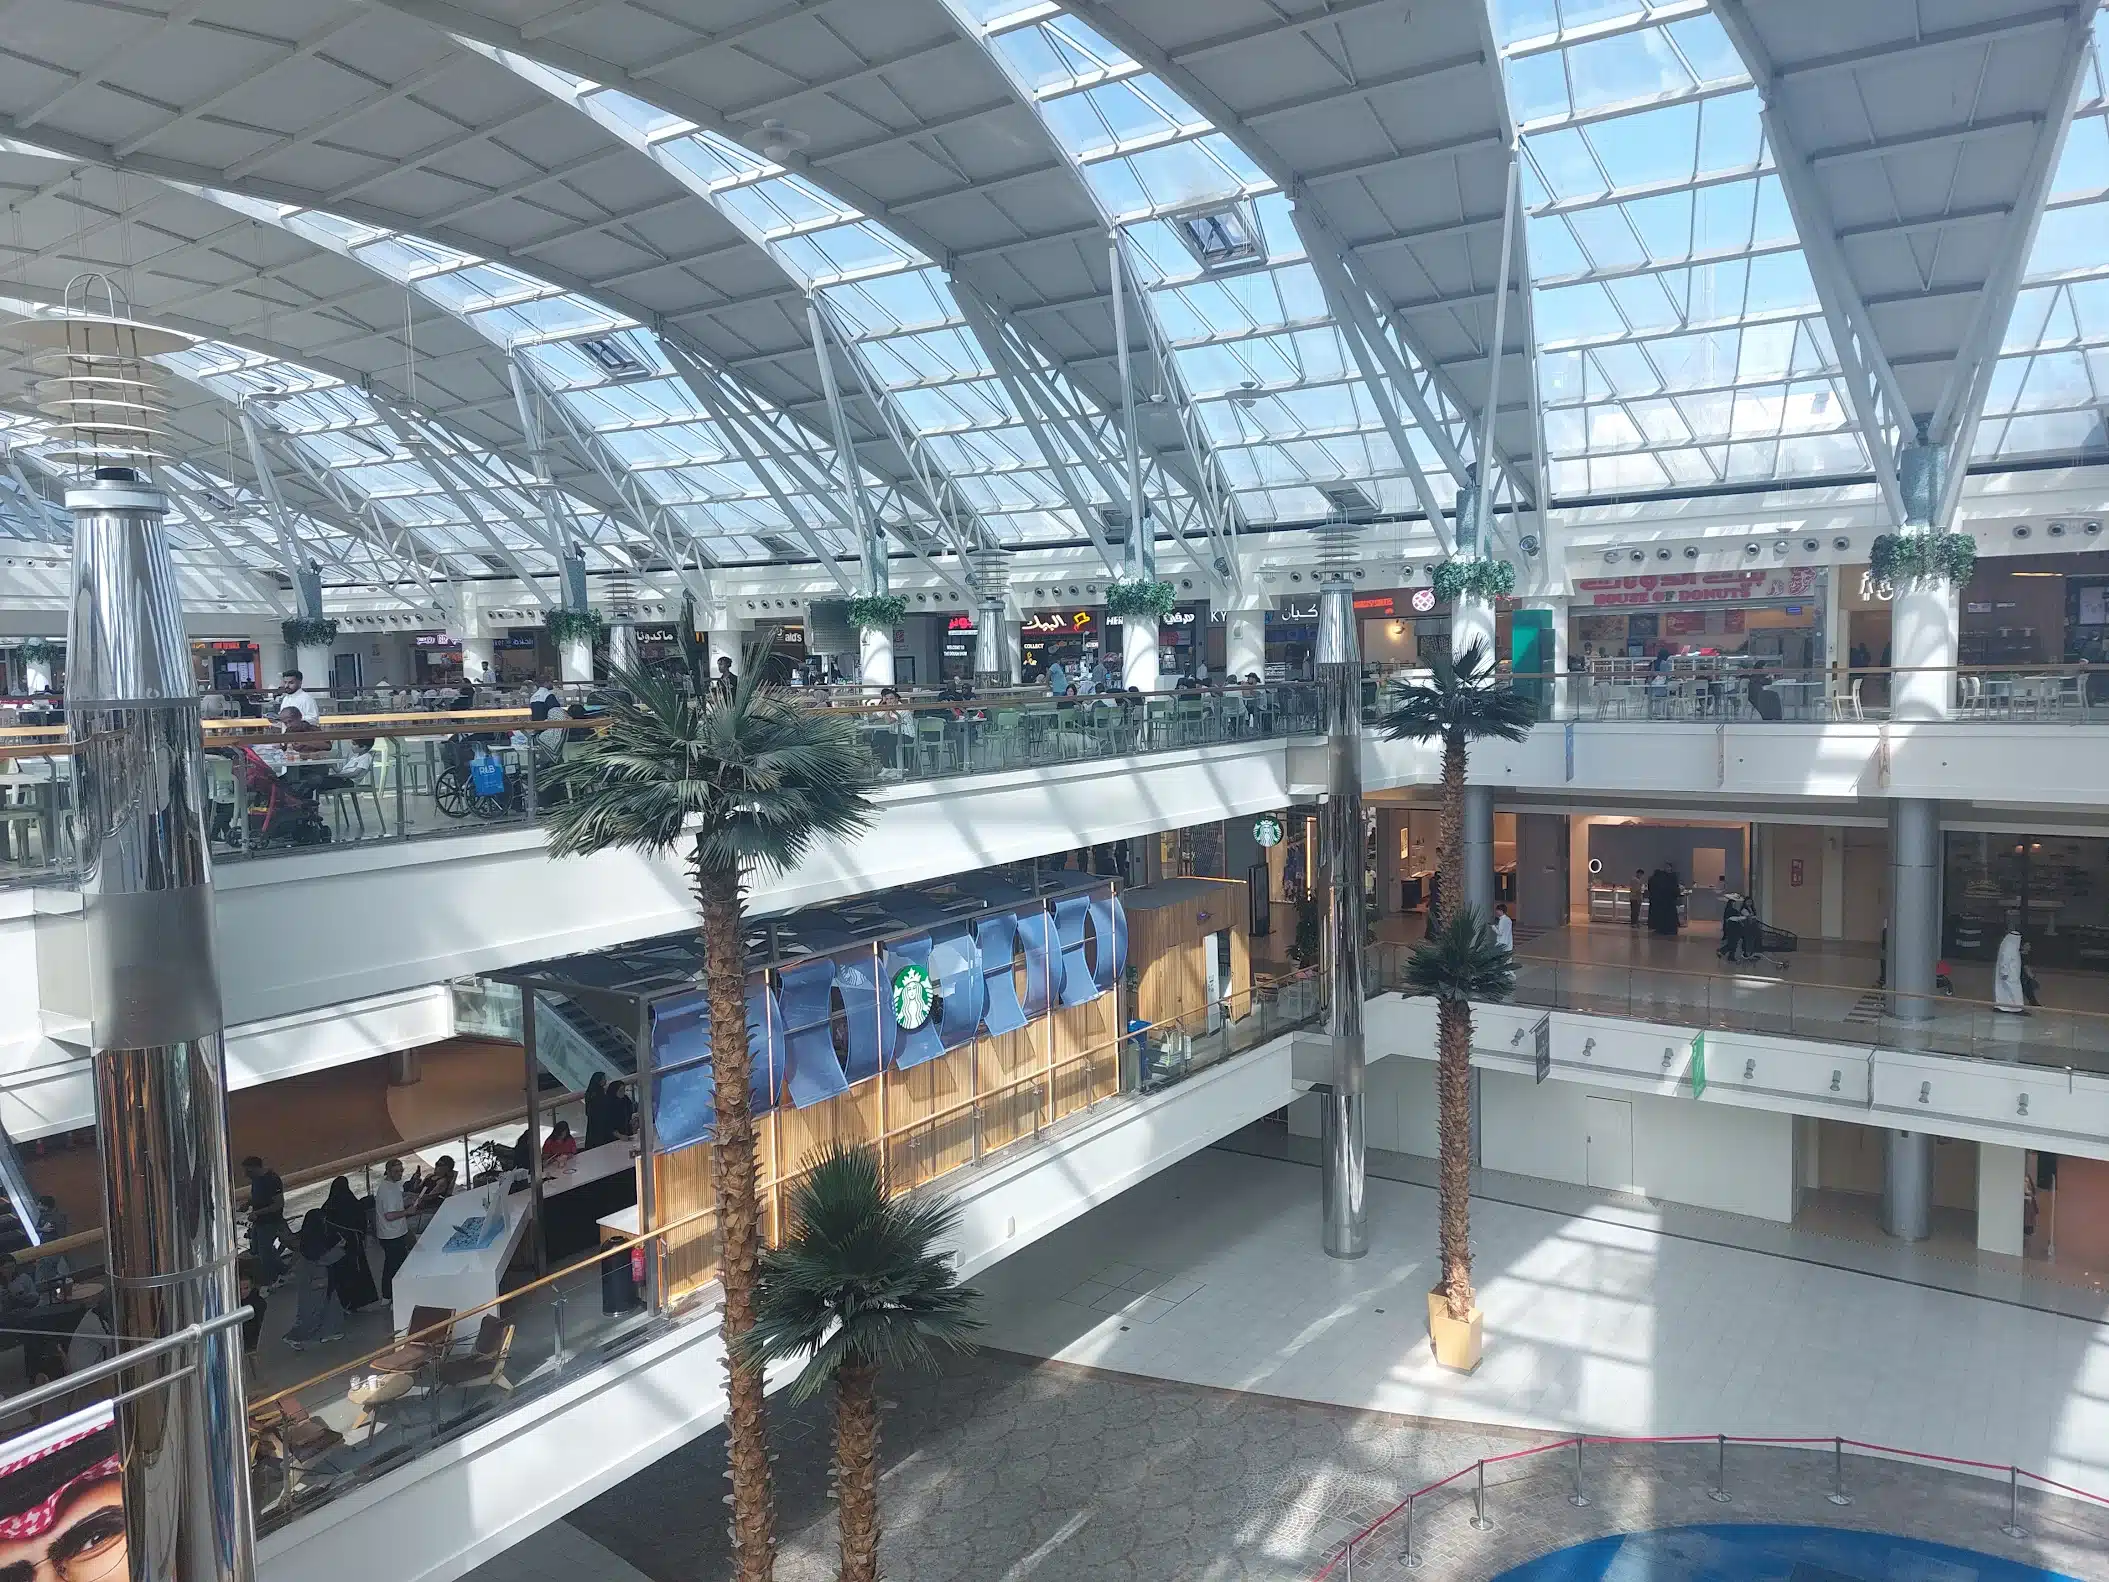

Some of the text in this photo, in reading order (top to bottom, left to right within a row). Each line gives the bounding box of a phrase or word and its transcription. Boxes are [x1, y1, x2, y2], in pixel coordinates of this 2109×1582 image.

[1593, 583, 1752, 606] HOUSE OF DONUTS
[1281, 604, 1319, 621] كيان
[1022, 614, 1067, 631] البيك
